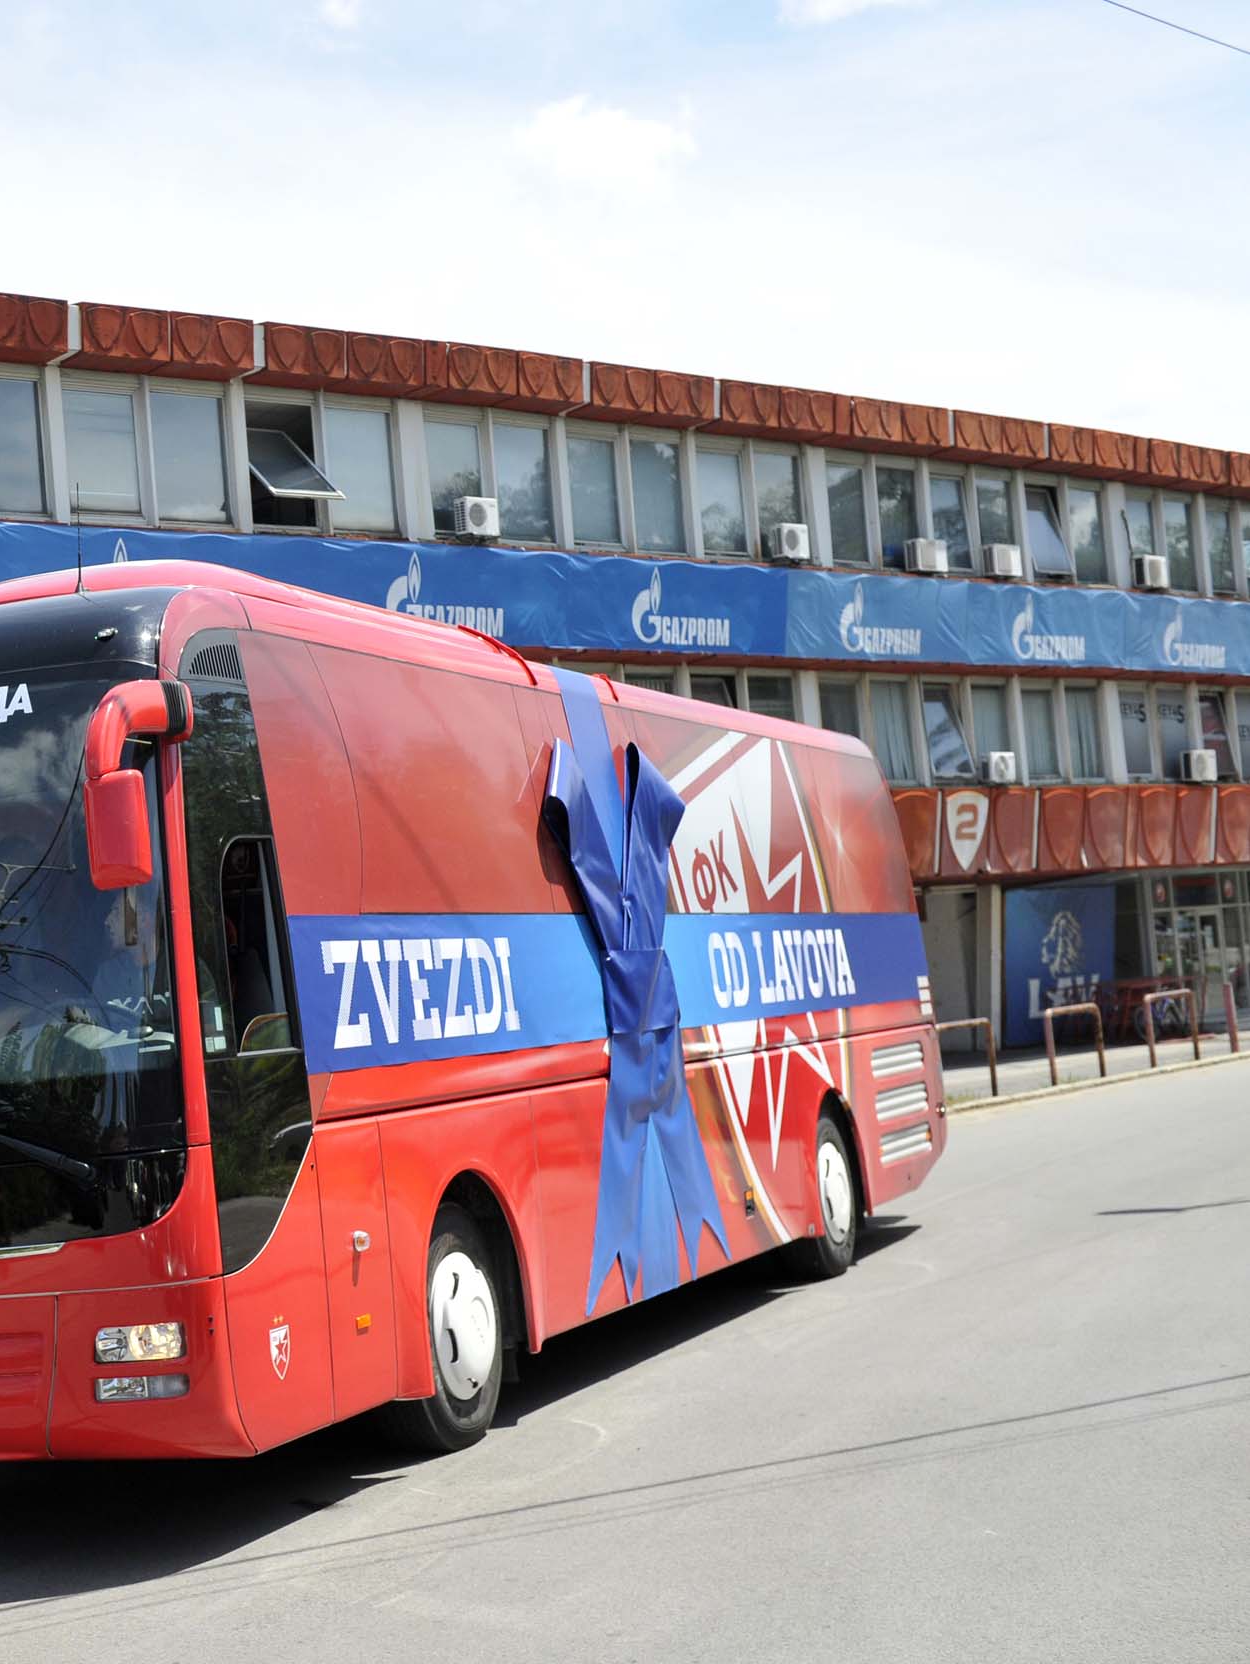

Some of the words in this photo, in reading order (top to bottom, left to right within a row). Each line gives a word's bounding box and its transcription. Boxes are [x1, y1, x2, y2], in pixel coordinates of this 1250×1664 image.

[661, 616, 730, 647] GAZPROM
[863, 627, 921, 655] GAZPROM
[1035, 635, 1085, 660] GAZPROM
[1181, 643, 1226, 668] GAZPROM
[956, 803, 979, 840] 2
[692, 829, 738, 913] ФК
[708, 931, 750, 1008] OD
[751, 928, 856, 1004] LAVOVA
[320, 937, 521, 1049] ZVEZDI
